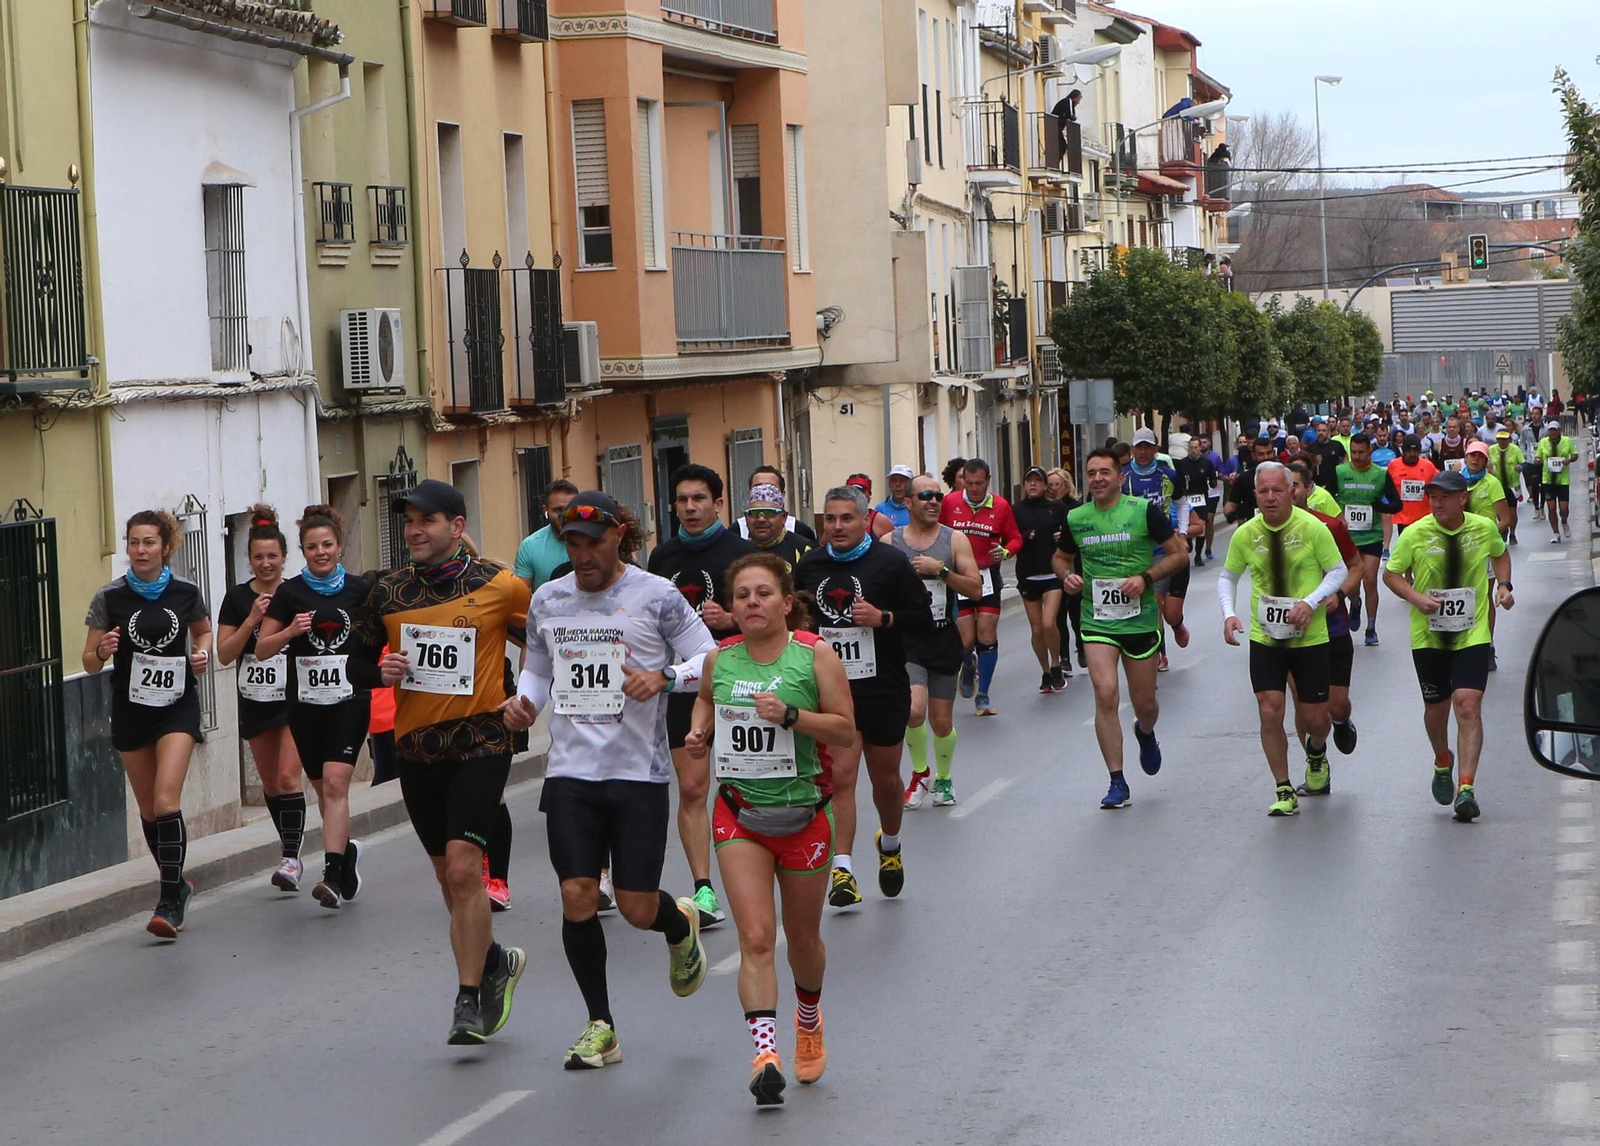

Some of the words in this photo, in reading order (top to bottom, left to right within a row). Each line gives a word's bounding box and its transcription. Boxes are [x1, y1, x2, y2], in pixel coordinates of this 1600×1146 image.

[840, 403, 853, 415] 51
[1405, 485, 1421, 494] 589
[1350, 511, 1366, 521] 901
[966, 521, 993, 531] Lentos
[1082, 535, 1100, 545] MEDIO
[1101, 532, 1131, 543] MARATÓN
[553, 627, 567, 639] VIII
[567, 628, 588, 637] MEDIA
[588, 627, 623, 638] MARATÓN
[554, 635, 580, 645] CIUDAD
[580, 634, 590, 642] DE
[590, 634, 620, 643] LUCENA
[416, 643, 458, 670] 766
[832, 641, 861, 661] 811
[140, 668, 175, 689] 248
[247, 666, 276, 685] 236
[308, 668, 341, 687] 844
[570, 663, 611, 689] 314
[731, 725, 776, 753] 907
